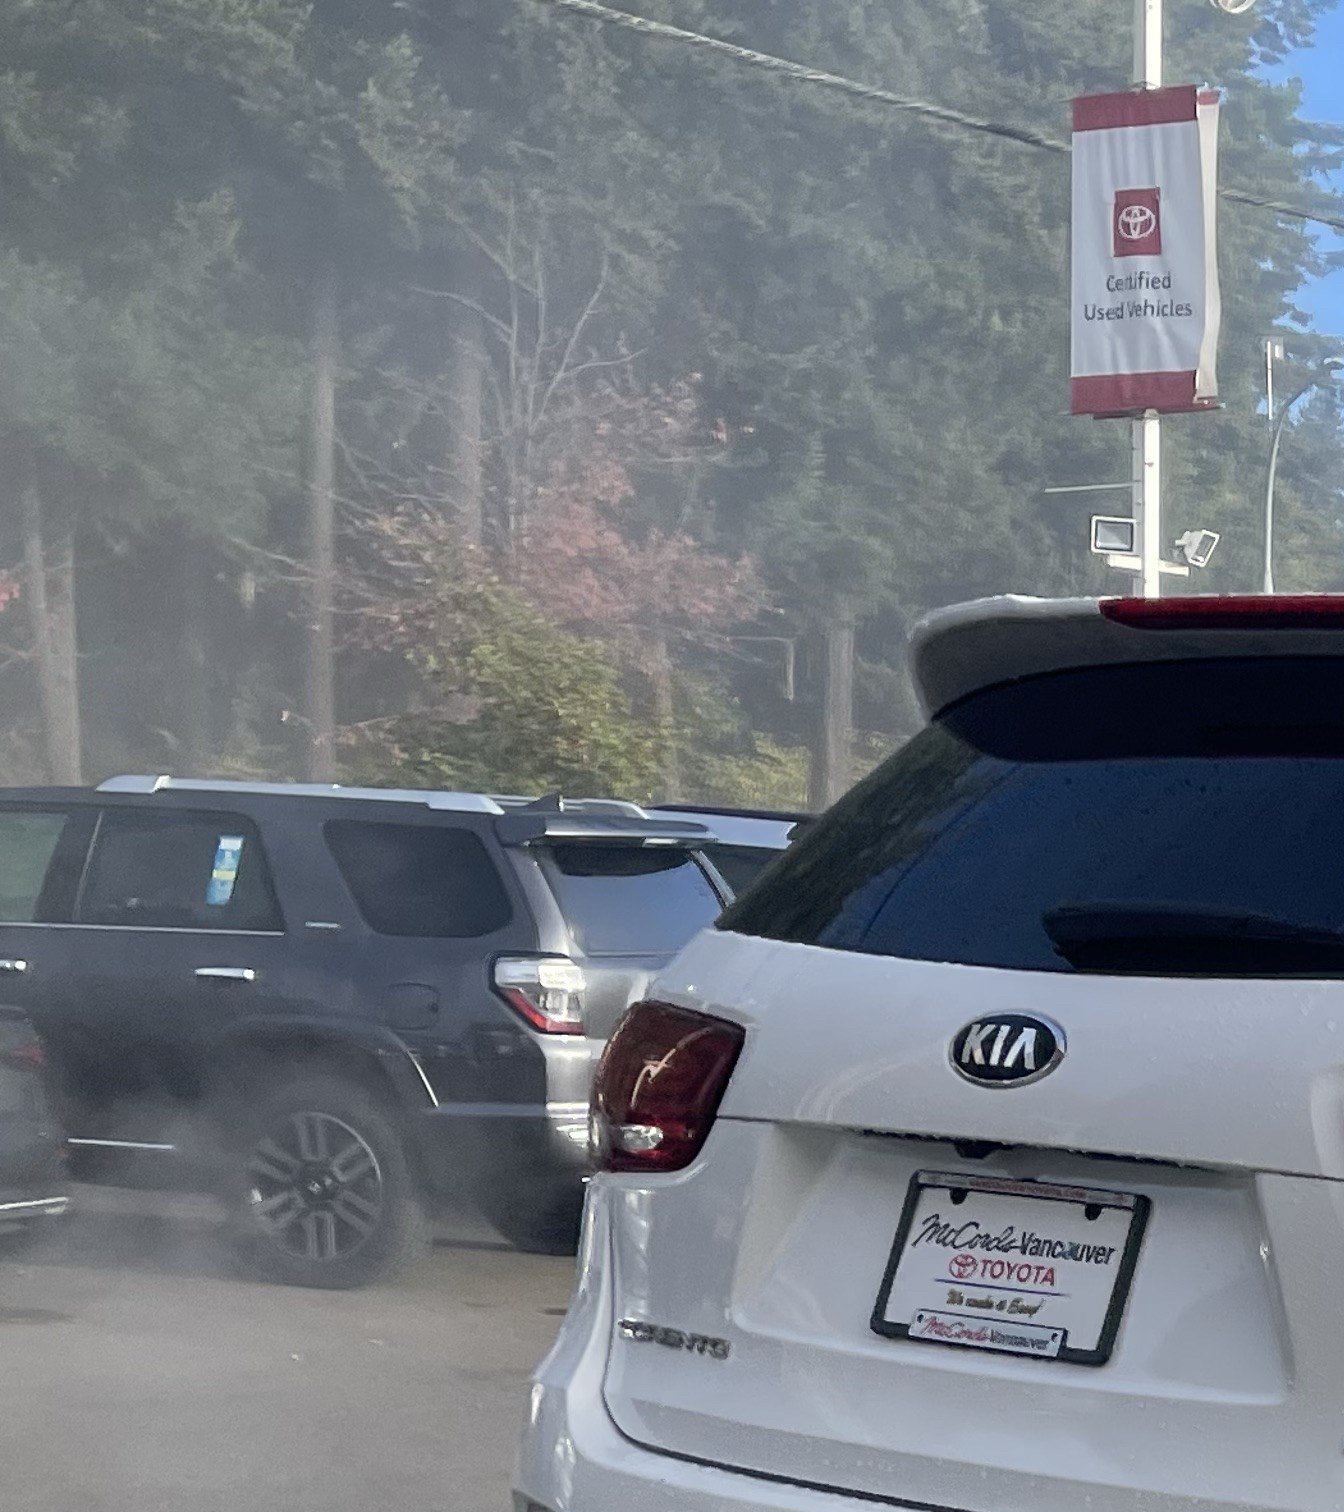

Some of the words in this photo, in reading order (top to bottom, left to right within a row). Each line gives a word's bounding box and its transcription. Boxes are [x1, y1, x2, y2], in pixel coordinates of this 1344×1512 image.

[1084, 302, 1124, 321] Used
[1126, 299, 1193, 318] Vehicles
[961, 1023, 1037, 1071] KIA
[1020, 1230, 1118, 1266] Vancouver
[980, 1258, 1056, 1287] TOYOTA
